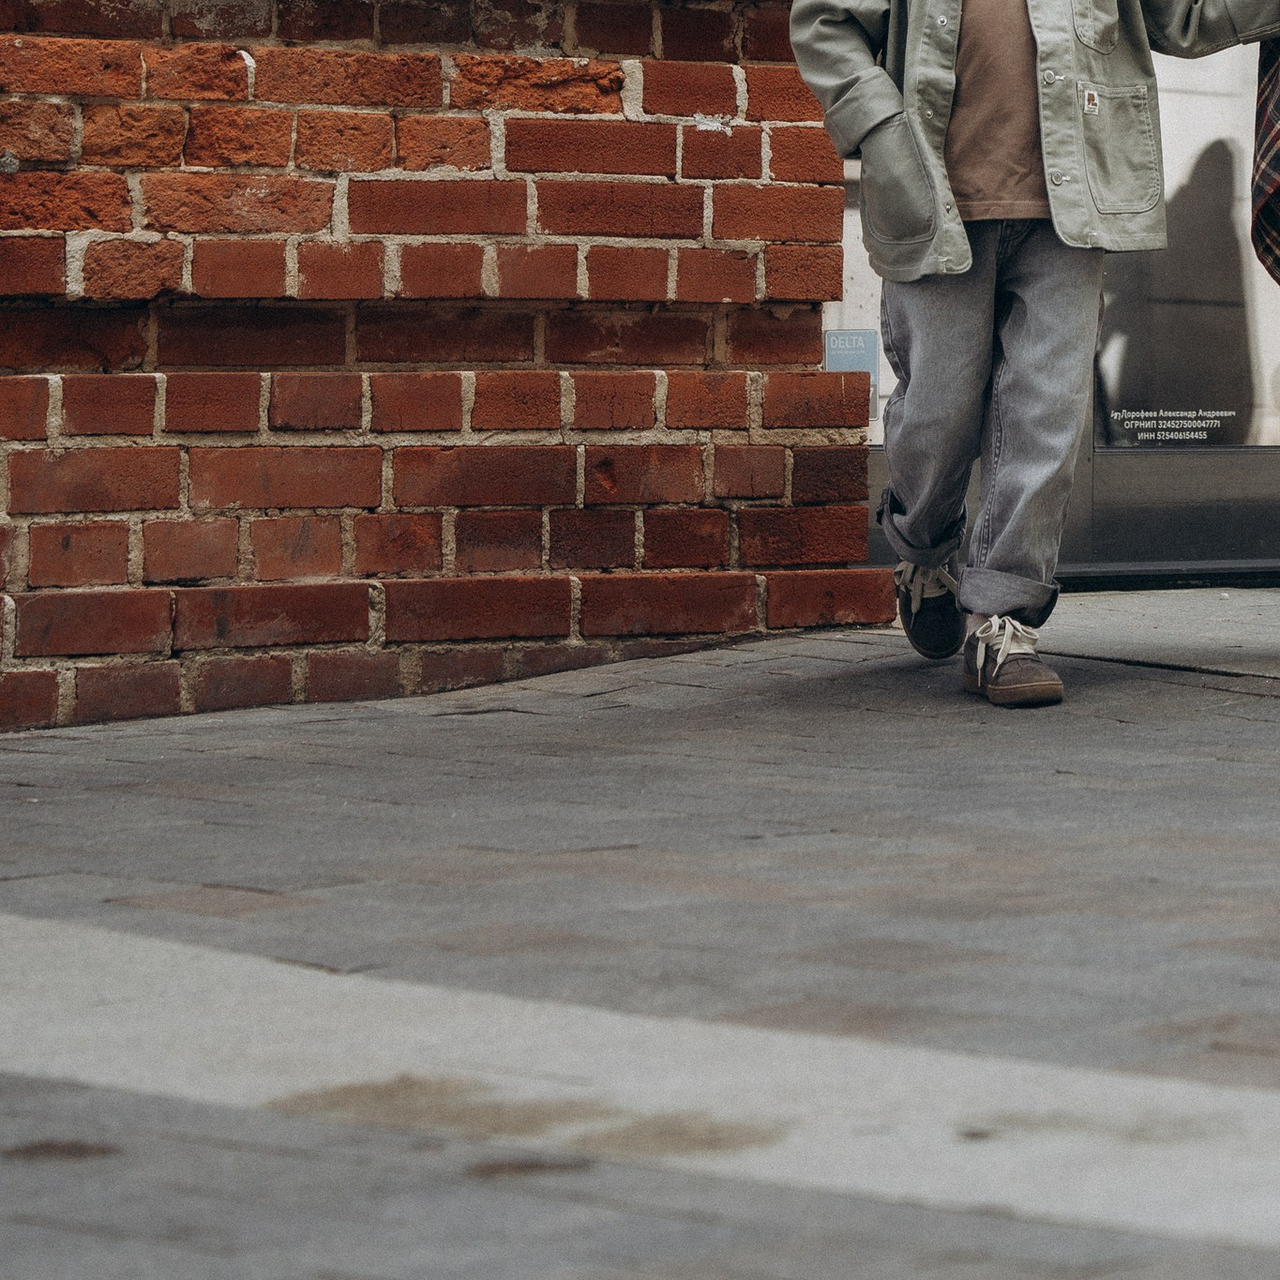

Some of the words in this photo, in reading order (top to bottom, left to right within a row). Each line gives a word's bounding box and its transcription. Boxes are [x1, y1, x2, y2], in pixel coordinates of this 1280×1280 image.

[830, 335, 865, 349] DELTA
[1158, 409, 1197, 420] Александр
[1197, 409, 1236, 419] Андреевич
[1124, 420, 1157, 429] ОГРНИП
[1157, 420, 1221, 429] 324527500047771
[1137, 432, 1156, 441] ИНН
[1156, 431, 1208, 440] 525406154455
